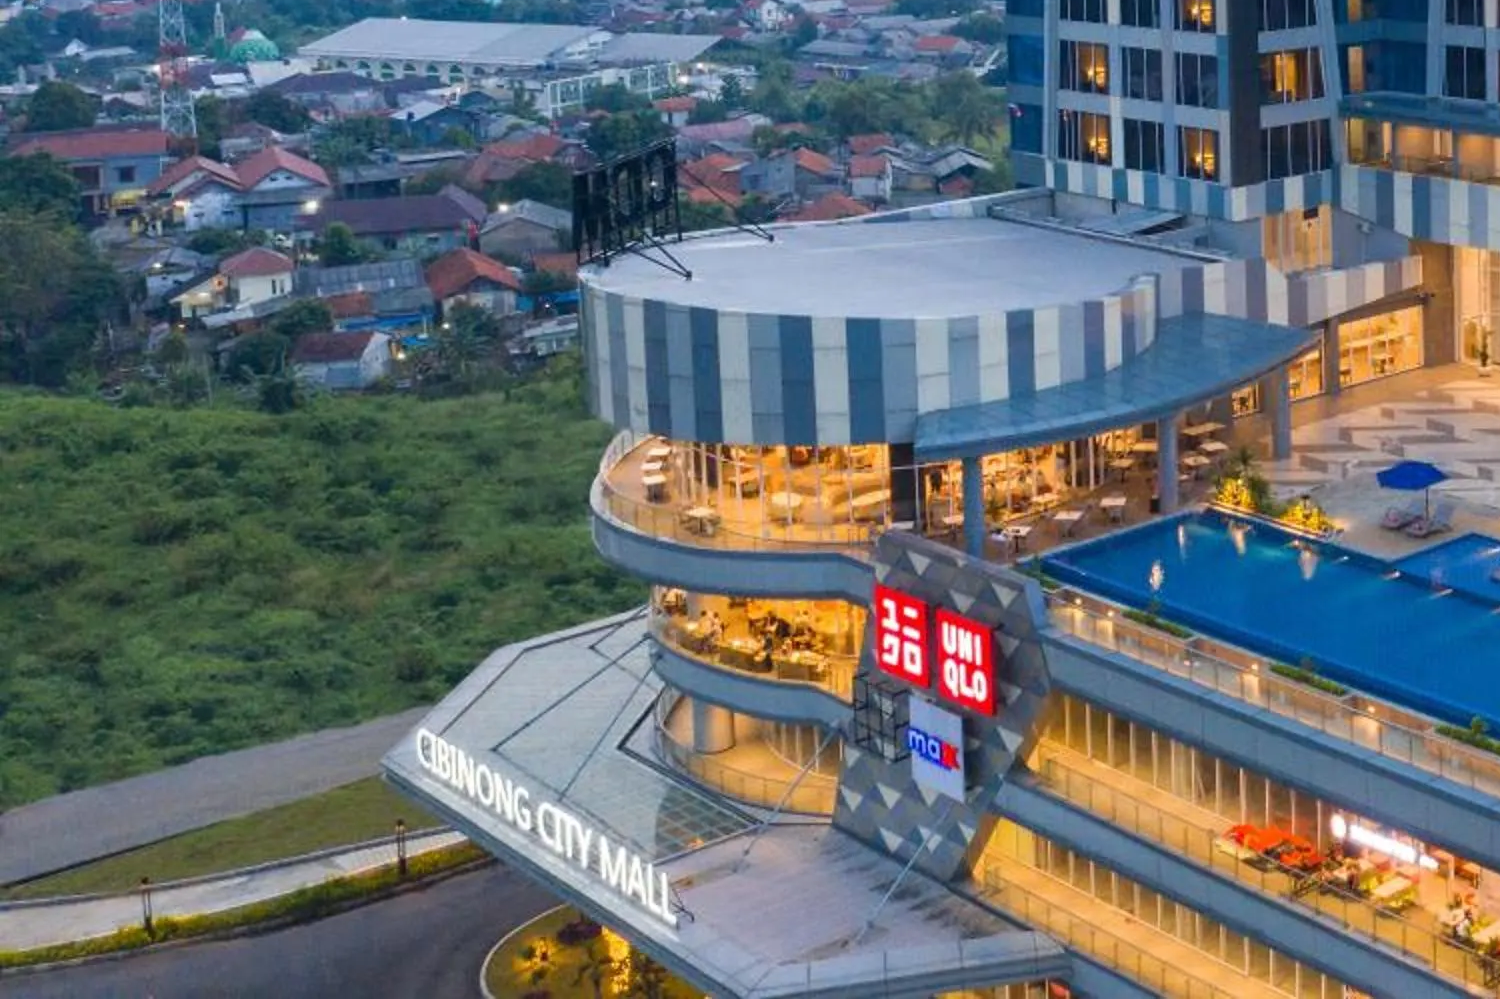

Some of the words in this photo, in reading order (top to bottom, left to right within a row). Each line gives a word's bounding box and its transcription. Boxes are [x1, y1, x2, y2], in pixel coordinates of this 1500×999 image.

[941, 622, 982, 665] UNI
[943, 658, 987, 702] QLO
[417, 728, 531, 831] CIBINONG
[537, 802, 593, 869] CITY
[599, 835, 677, 926] MALL
